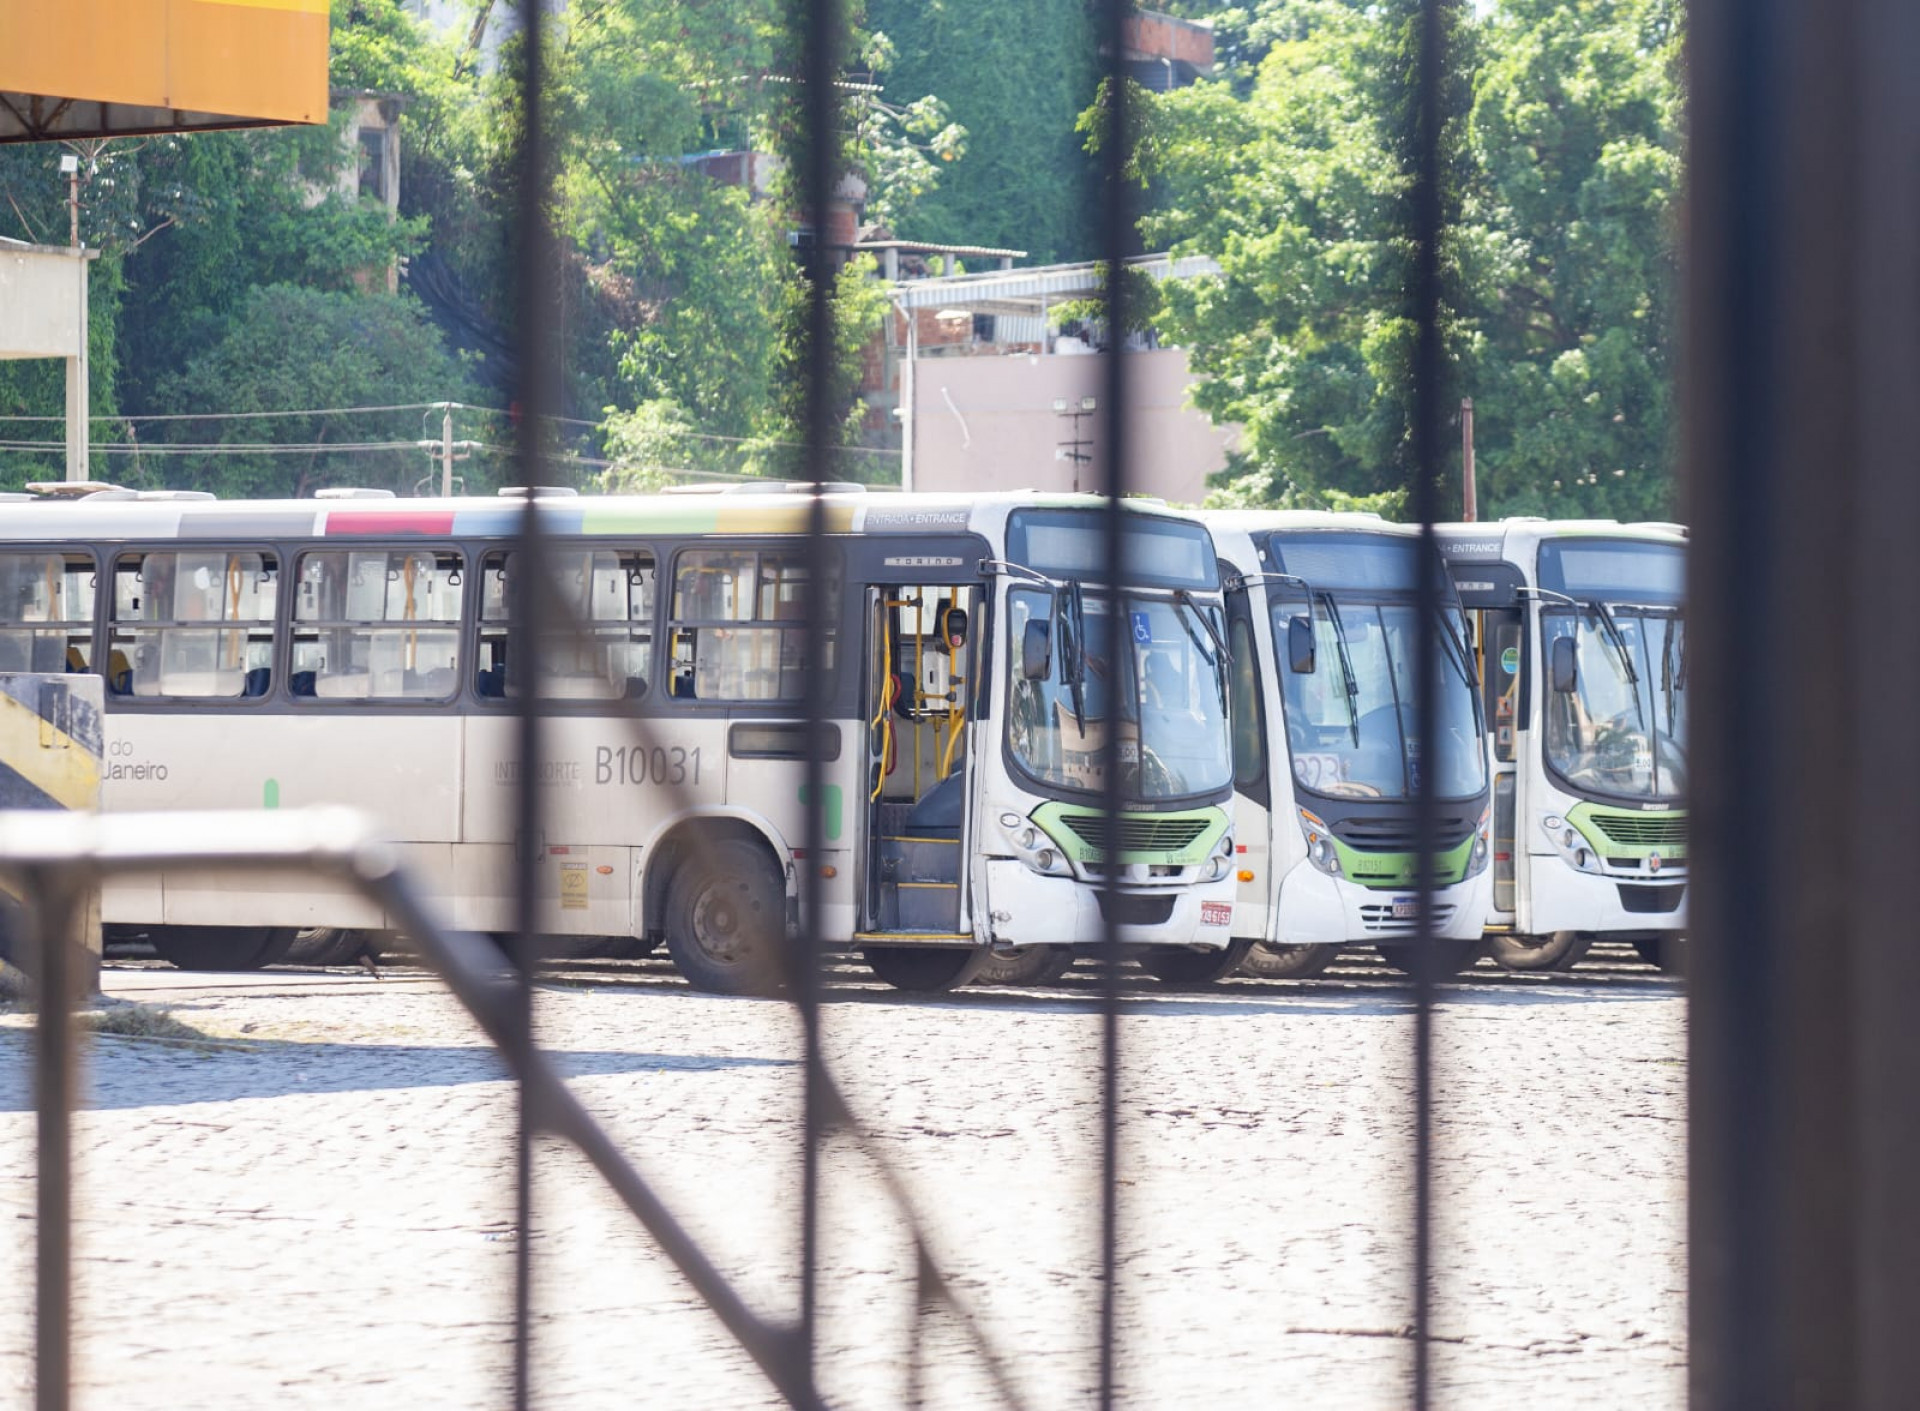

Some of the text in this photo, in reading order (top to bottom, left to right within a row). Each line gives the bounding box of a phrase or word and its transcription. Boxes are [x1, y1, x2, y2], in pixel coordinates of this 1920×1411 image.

[916, 513, 966, 523] ENTRANCE
[1452, 543, 1501, 553] ENTRANCE
[109, 738, 133, 756] do
[103, 760, 168, 781] Janeiro
[595, 746, 701, 785] B10031
